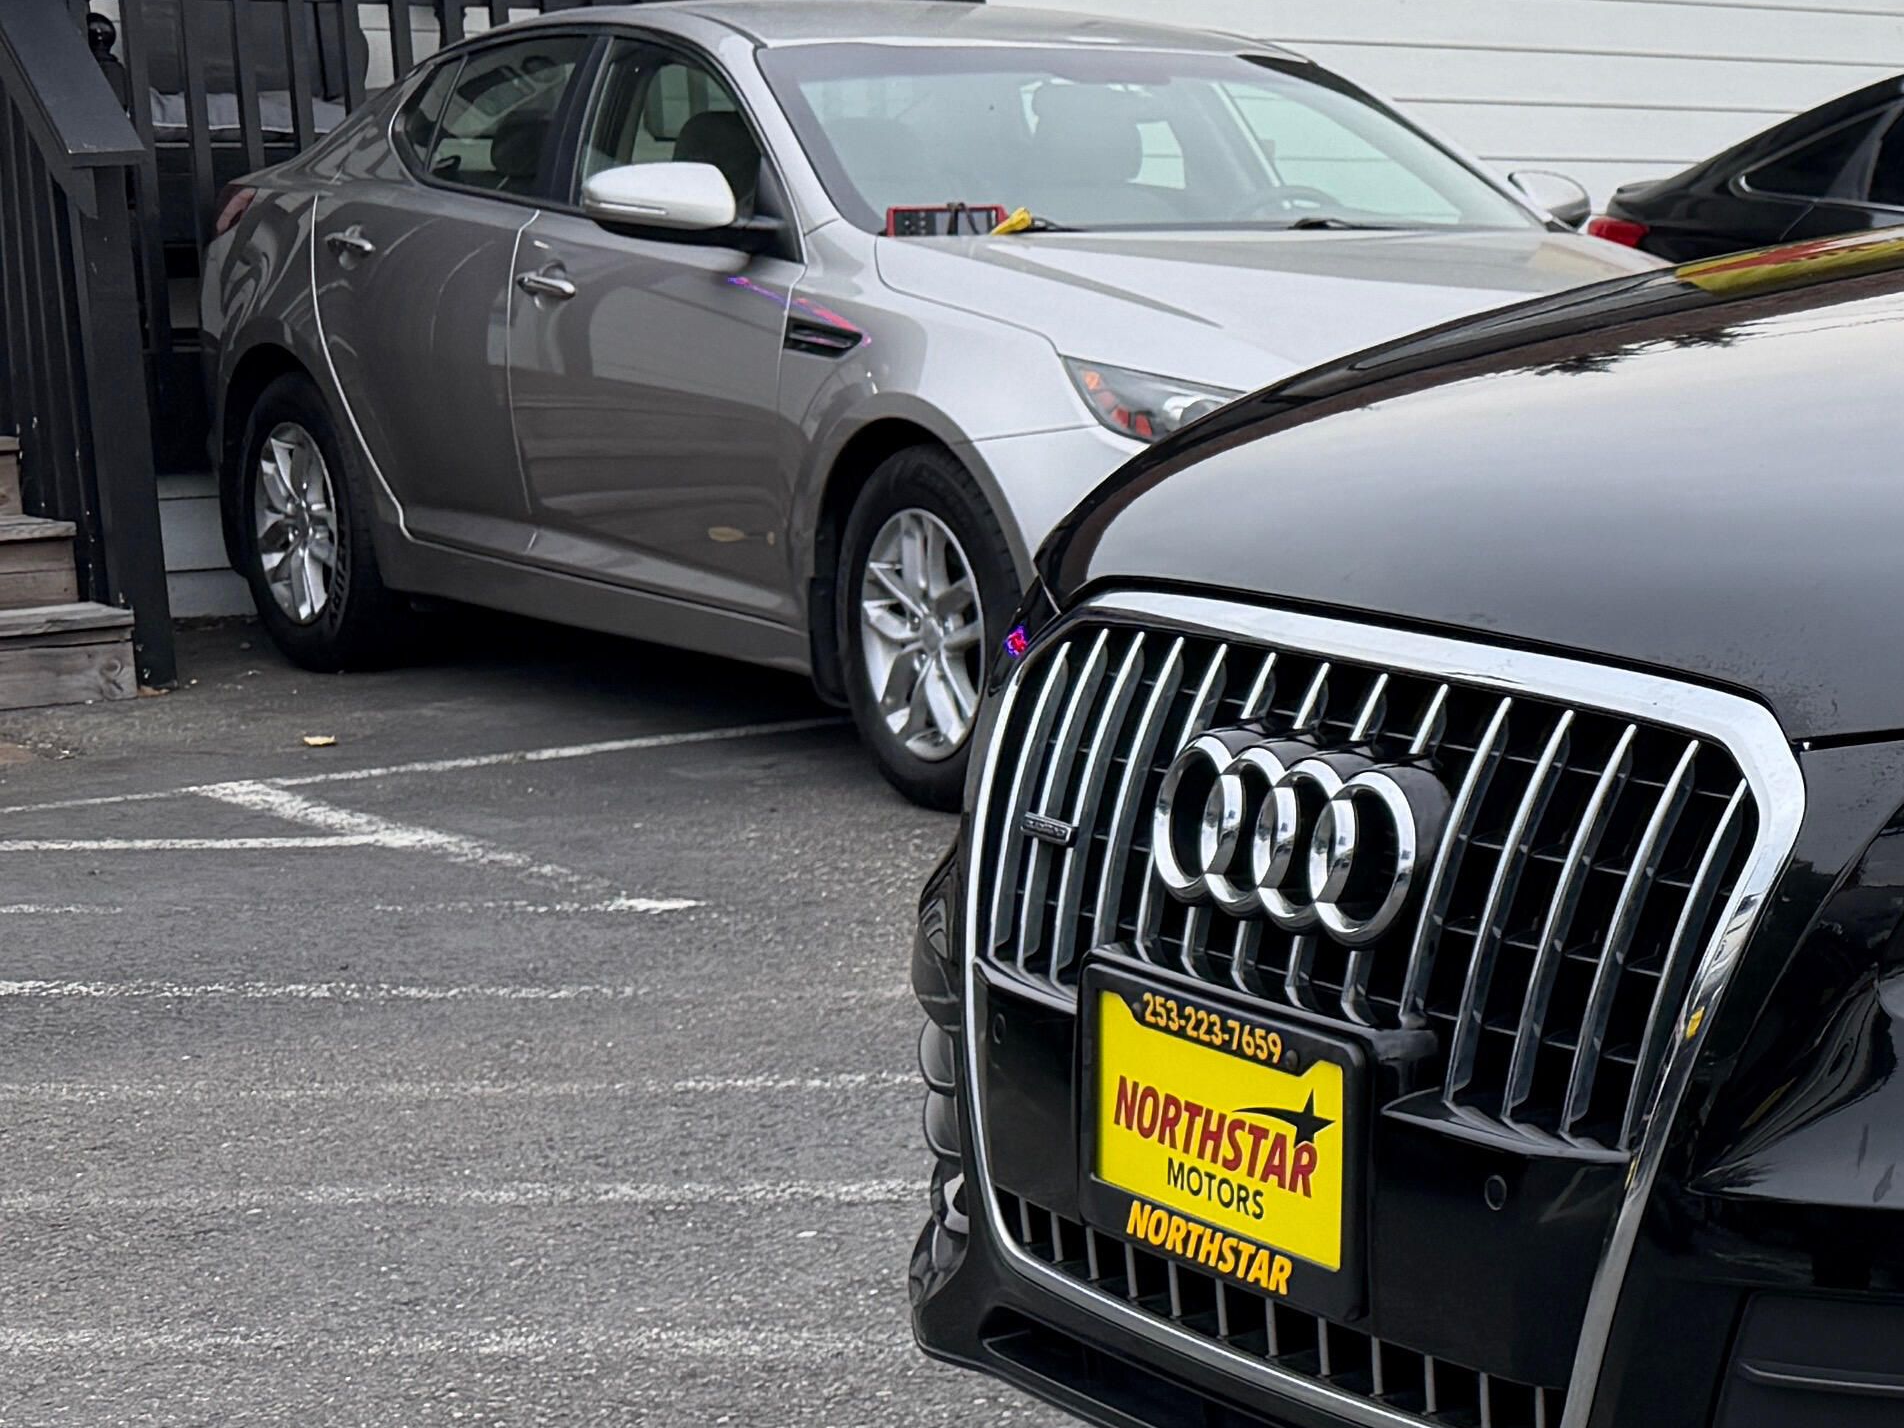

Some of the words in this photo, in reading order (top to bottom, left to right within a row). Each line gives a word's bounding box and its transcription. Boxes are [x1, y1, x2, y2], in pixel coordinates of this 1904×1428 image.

[1142, 992, 1283, 1063] 253-223-7659
[1113, 1075, 1318, 1198] NORTHSTAR
[1167, 1157, 1265, 1220] MOTORS
[1126, 1200, 1293, 1295] NORTHSTAR
